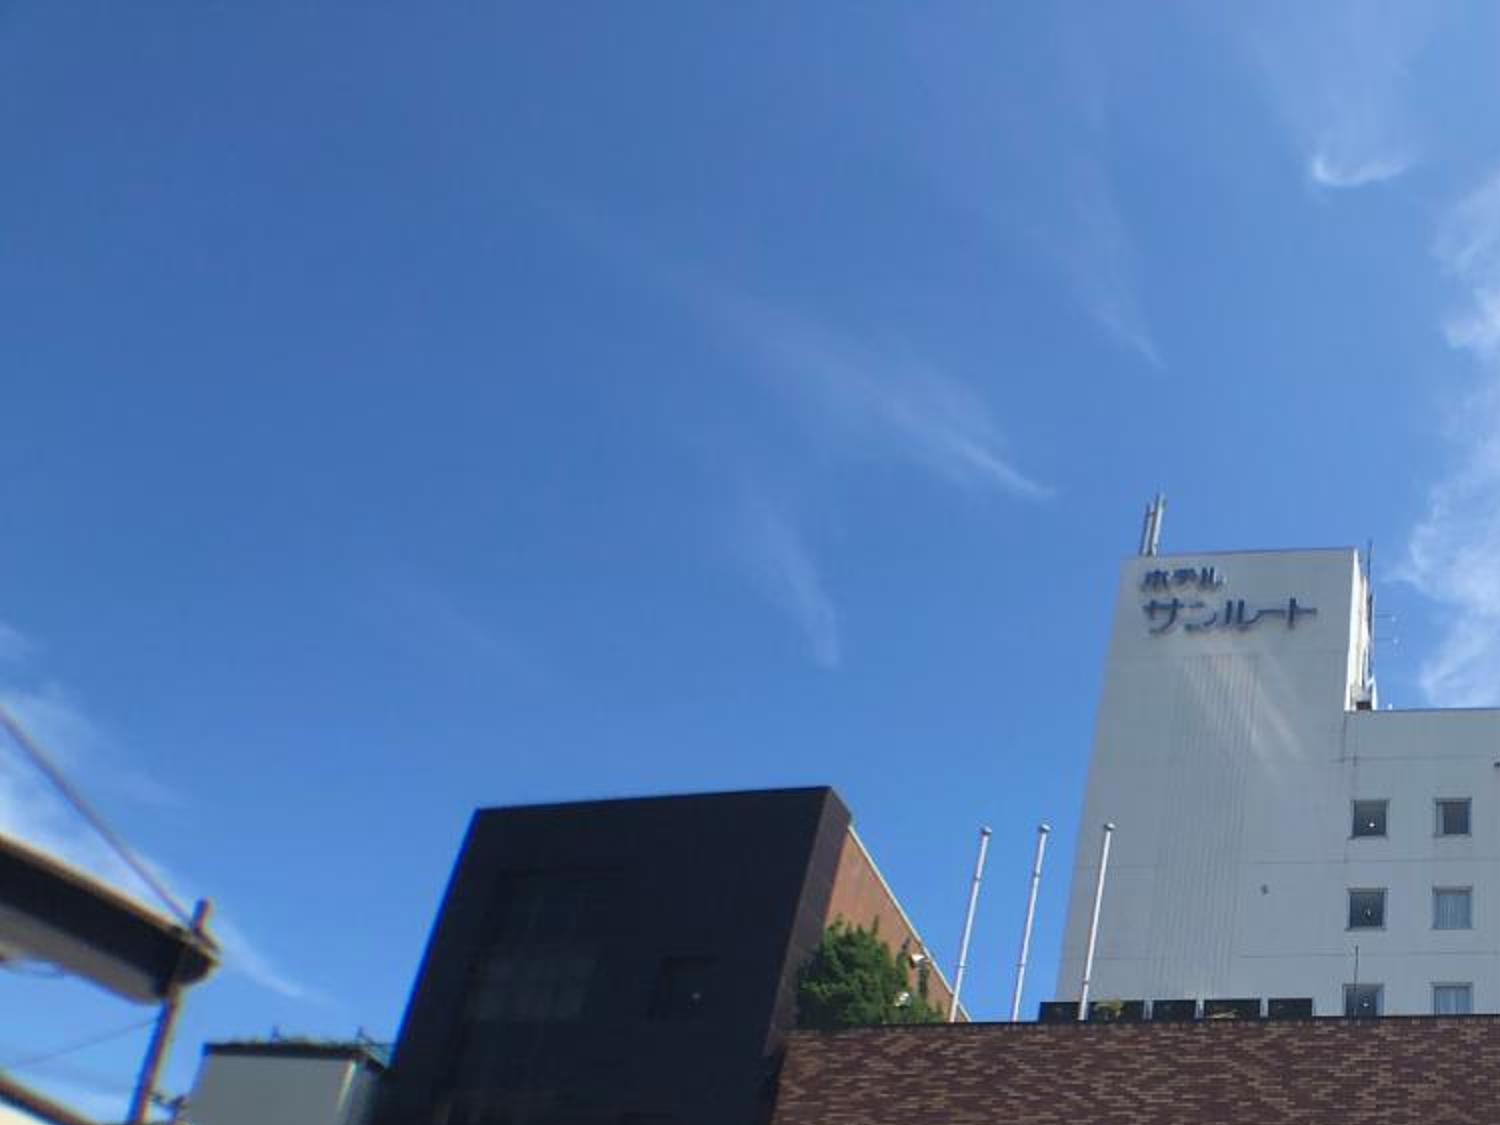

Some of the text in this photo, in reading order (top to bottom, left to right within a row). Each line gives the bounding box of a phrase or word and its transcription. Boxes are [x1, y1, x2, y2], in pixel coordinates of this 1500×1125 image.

[1142, 566, 1222, 591] ホテル
[1142, 597, 1318, 634] サンルート
